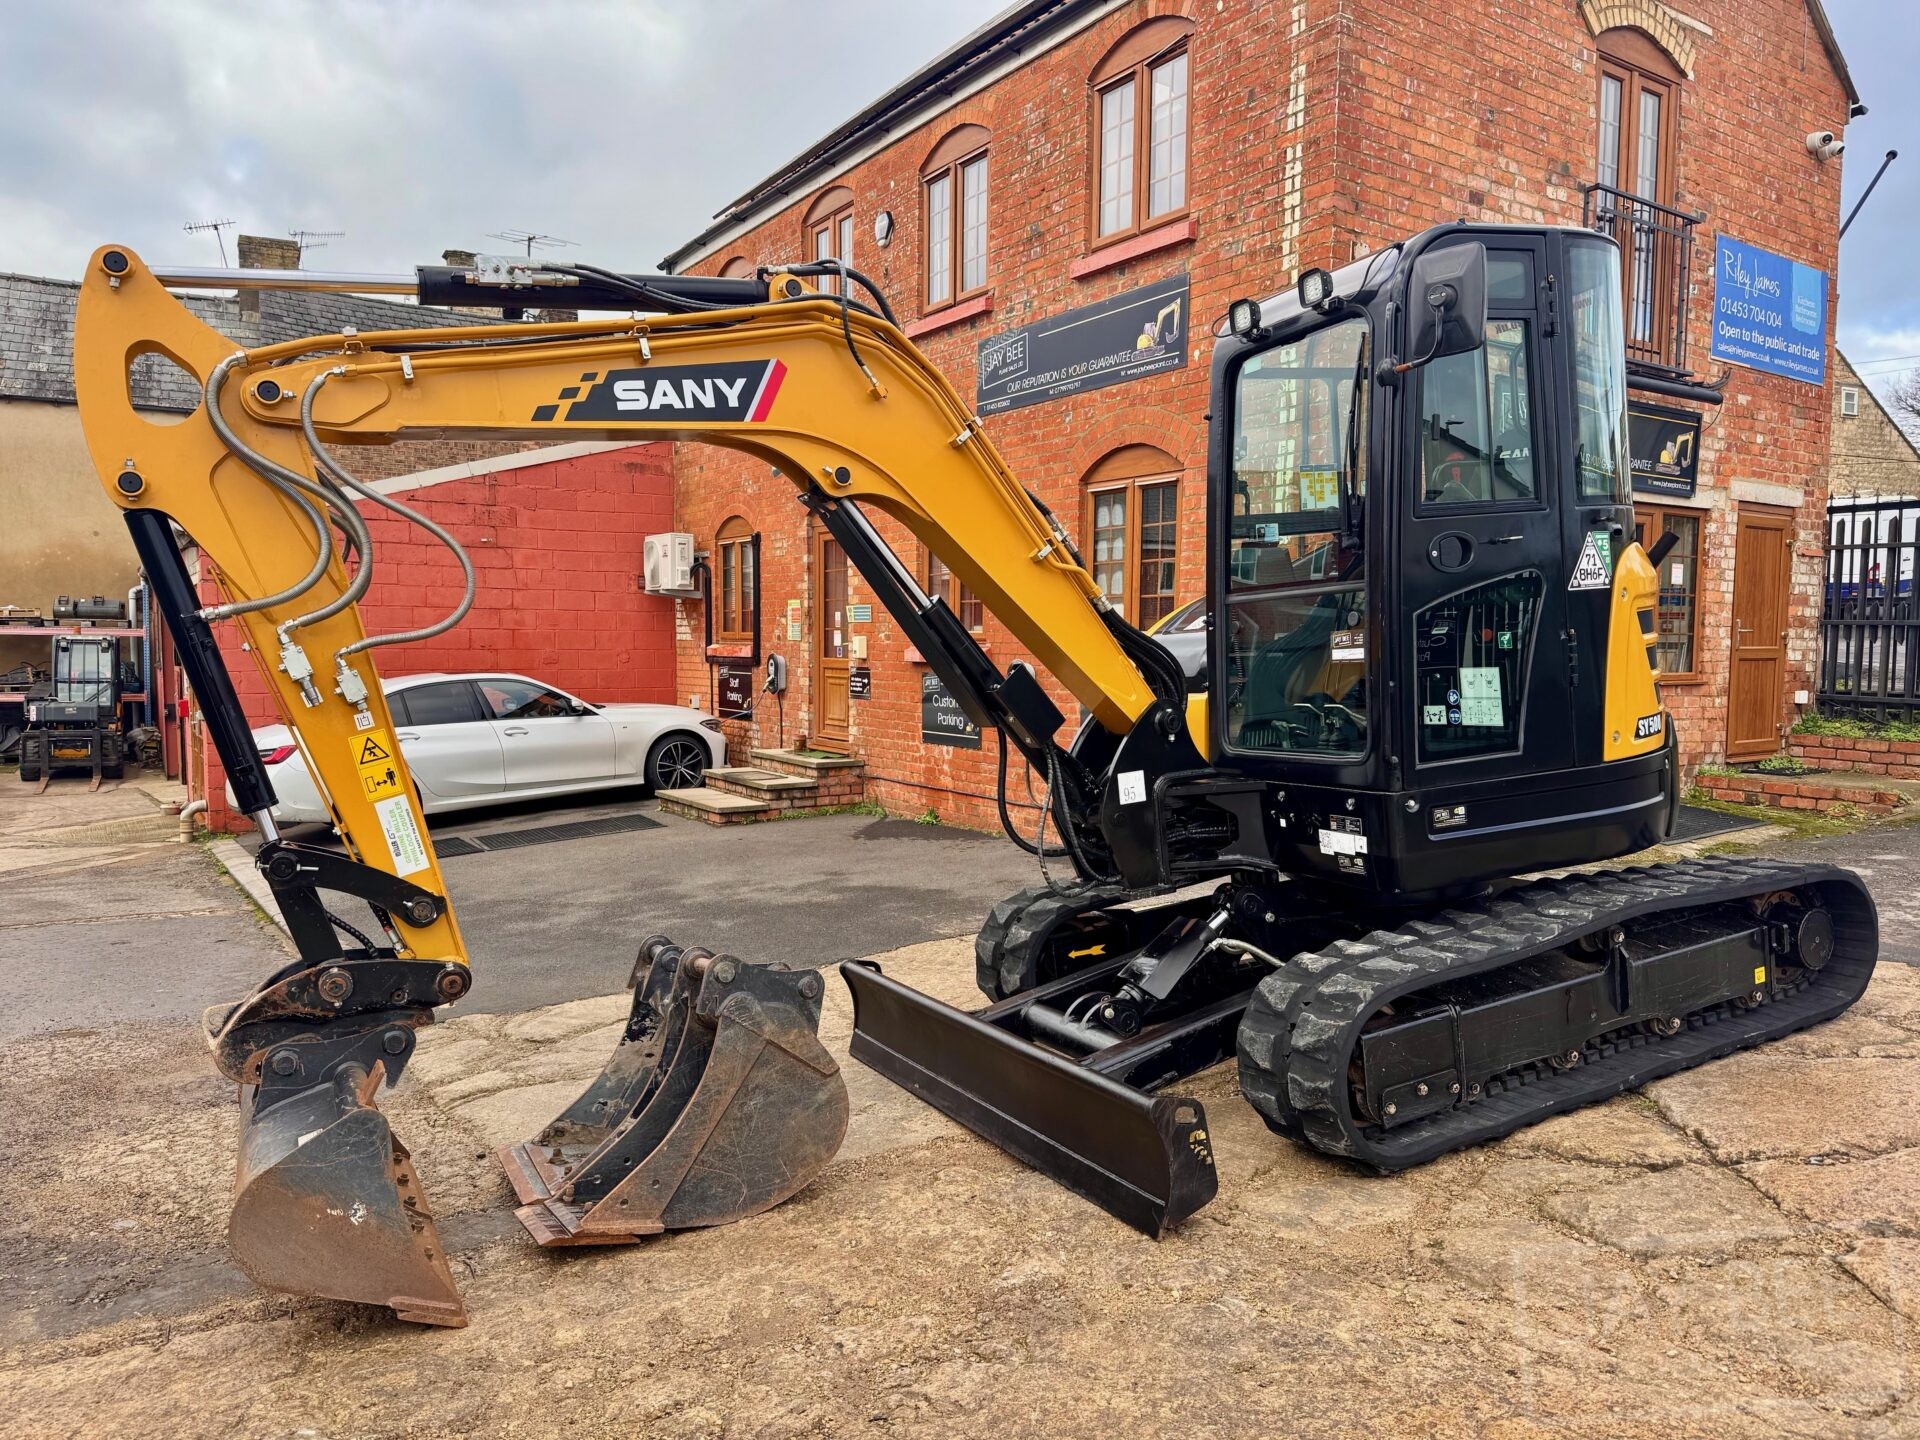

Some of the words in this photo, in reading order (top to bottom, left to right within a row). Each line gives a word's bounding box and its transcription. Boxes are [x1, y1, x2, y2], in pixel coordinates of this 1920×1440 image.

[1722, 248, 1750, 299] Riley
[1752, 258, 1780, 298] James
[1720, 296, 1748, 319] 01453
[1750, 305, 1765, 324] 704
[1766, 310, 1782, 328] 004
[1718, 320, 1740, 338] Open
[1742, 328, 1750, 340] to
[1752, 330, 1764, 345] the
[1765, 336, 1787, 351] public
[1788, 342, 1800, 356] and
[1802, 345, 1820, 360] trade
[986, 350, 1004, 371] JAY
[1006, 341, 1023, 363] BEE
[1007, 382, 1020, 393] OUR
[1022, 370, 1059, 388] REPUTATION
[1061, 368, 1067, 379] IS
[1068, 362, 1087, 376] YOUR
[1088, 350, 1132, 371] GUARANTEE
[613, 378, 747, 410] SANY
[1602, 539, 1608, 550] 5
[1579, 567, 1603, 581] BH6F
[1585, 554, 1597, 567] 71
[729, 678, 739, 687] Staff
[727, 691, 742, 704] Parking
[938, 713, 964, 729] Parking
[389, 808, 401, 833] MILLER
[395, 800, 409, 831] COUPLER
[398, 834, 411, 863] GENUINE
